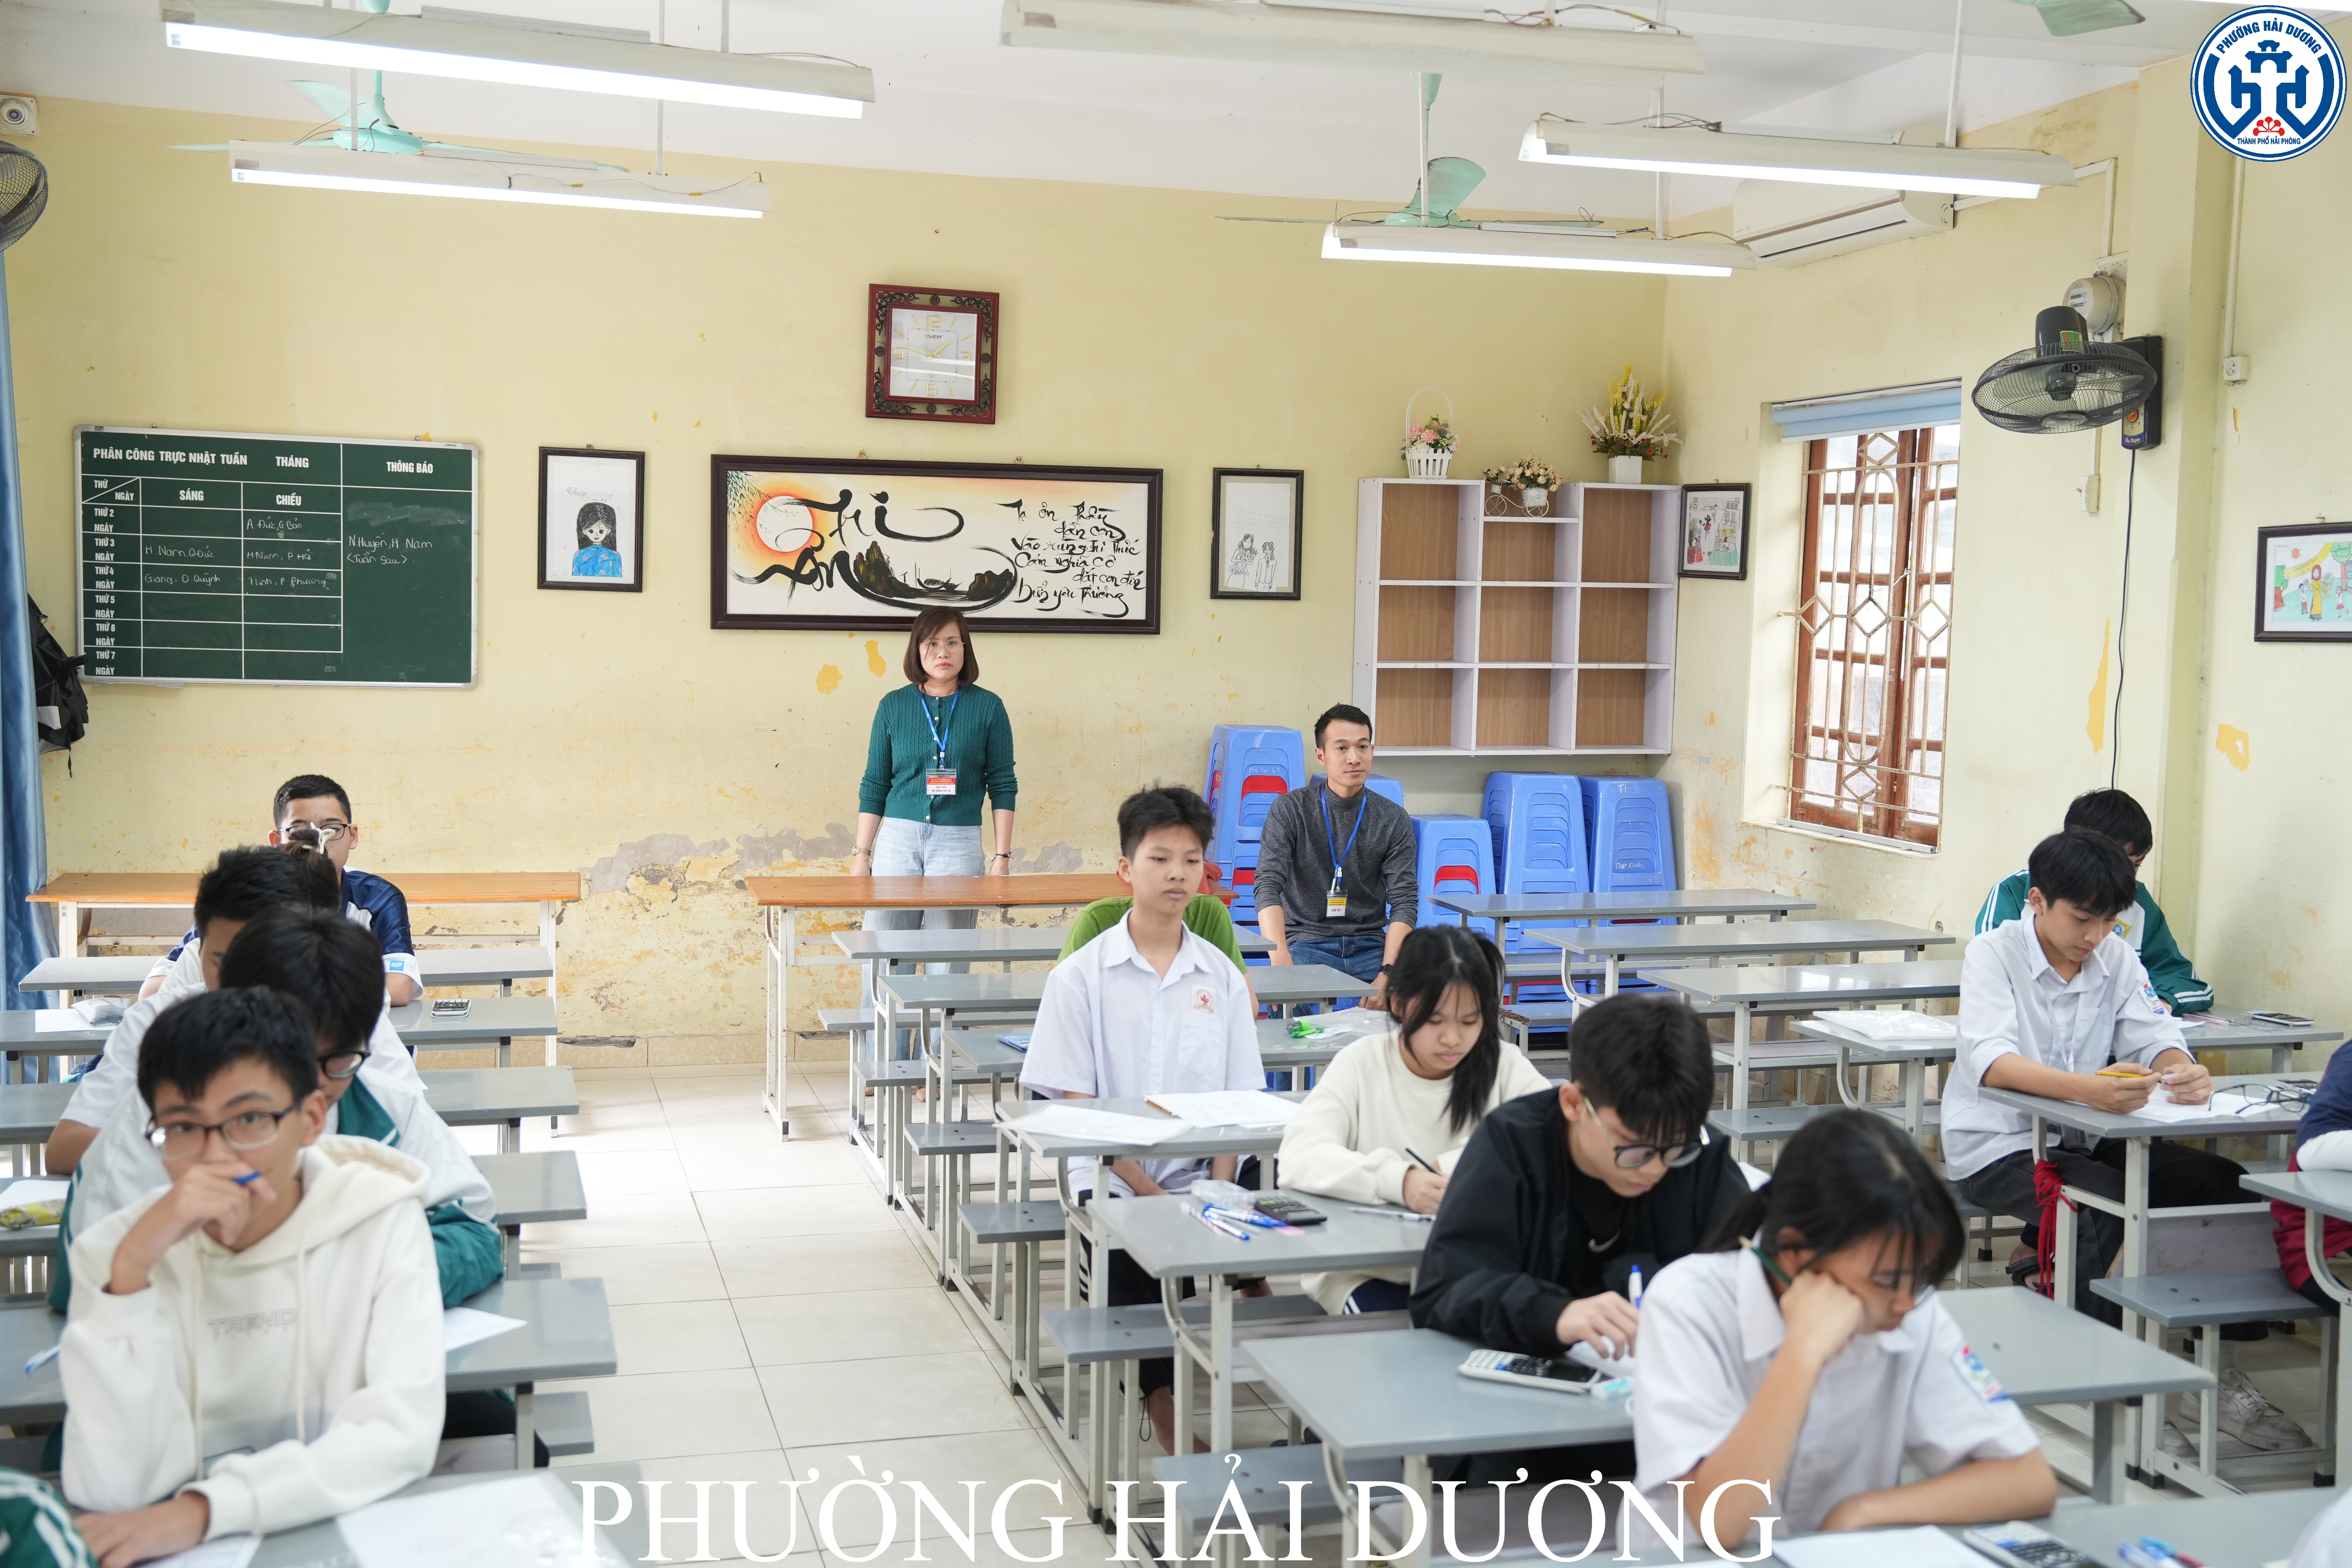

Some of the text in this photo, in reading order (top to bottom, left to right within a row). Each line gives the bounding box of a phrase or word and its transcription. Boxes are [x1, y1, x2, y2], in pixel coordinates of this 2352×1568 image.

[926, 315, 941, 329] 12
[893, 347, 904, 360] 9
[926, 383, 937, 396] 6
[93, 446, 248, 465] PHÂN CÔNG TRỰC NHẬT TUẦN
[275, 454, 309, 468] THÁNG
[386, 459, 433, 474] THÔNG BÁO
[94, 478, 109, 489] THỨ
[115, 491, 134, 501] NGÀY
[179, 487, 204, 501] SÁNG
[276, 492, 302, 506] CHIỀU
[94, 506, 114, 517] THỨ 2
[94, 522, 113, 532] NGÀY
[1090, 525, 1118, 539] con
[94, 536, 115, 547] THỨ 3
[406, 537, 433, 549] Nam
[95, 551, 114, 561] NGÀY
[95, 565, 109, 575] THỨ
[95, 579, 115, 589] NGÀY
[1099, 574, 1121, 587] con
[95, 593, 115, 604] THỨ 5
[95, 608, 115, 618] NGÀY
[95, 621, 116, 632] THỨ 6
[95, 636, 115, 646] NGÀY
[95, 649, 116, 659] THỨ 7
[95, 665, 115, 675] NGÀY
